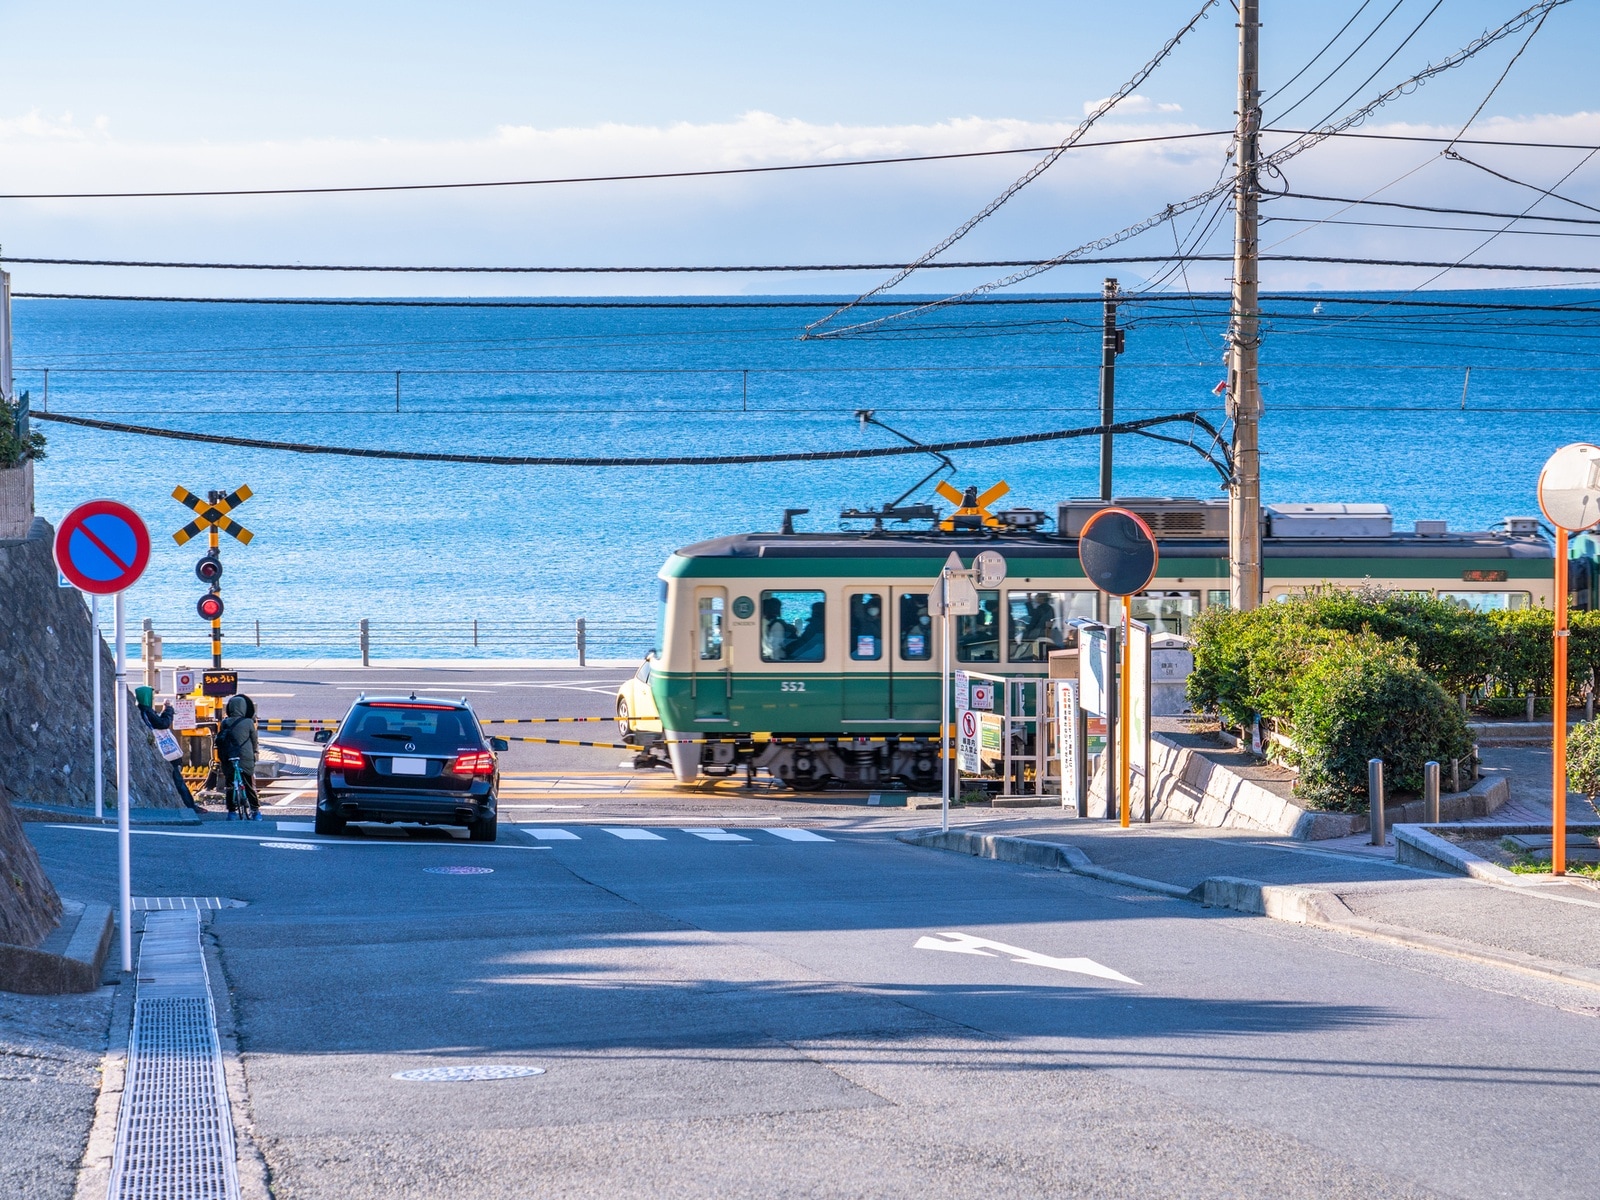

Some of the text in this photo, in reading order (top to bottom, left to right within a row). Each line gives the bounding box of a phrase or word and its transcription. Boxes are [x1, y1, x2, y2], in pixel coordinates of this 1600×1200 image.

[205, 674, 235, 684] ちゅうい
[781, 681, 806, 692] 552
[960, 744, 978, 755] 立入禁止
